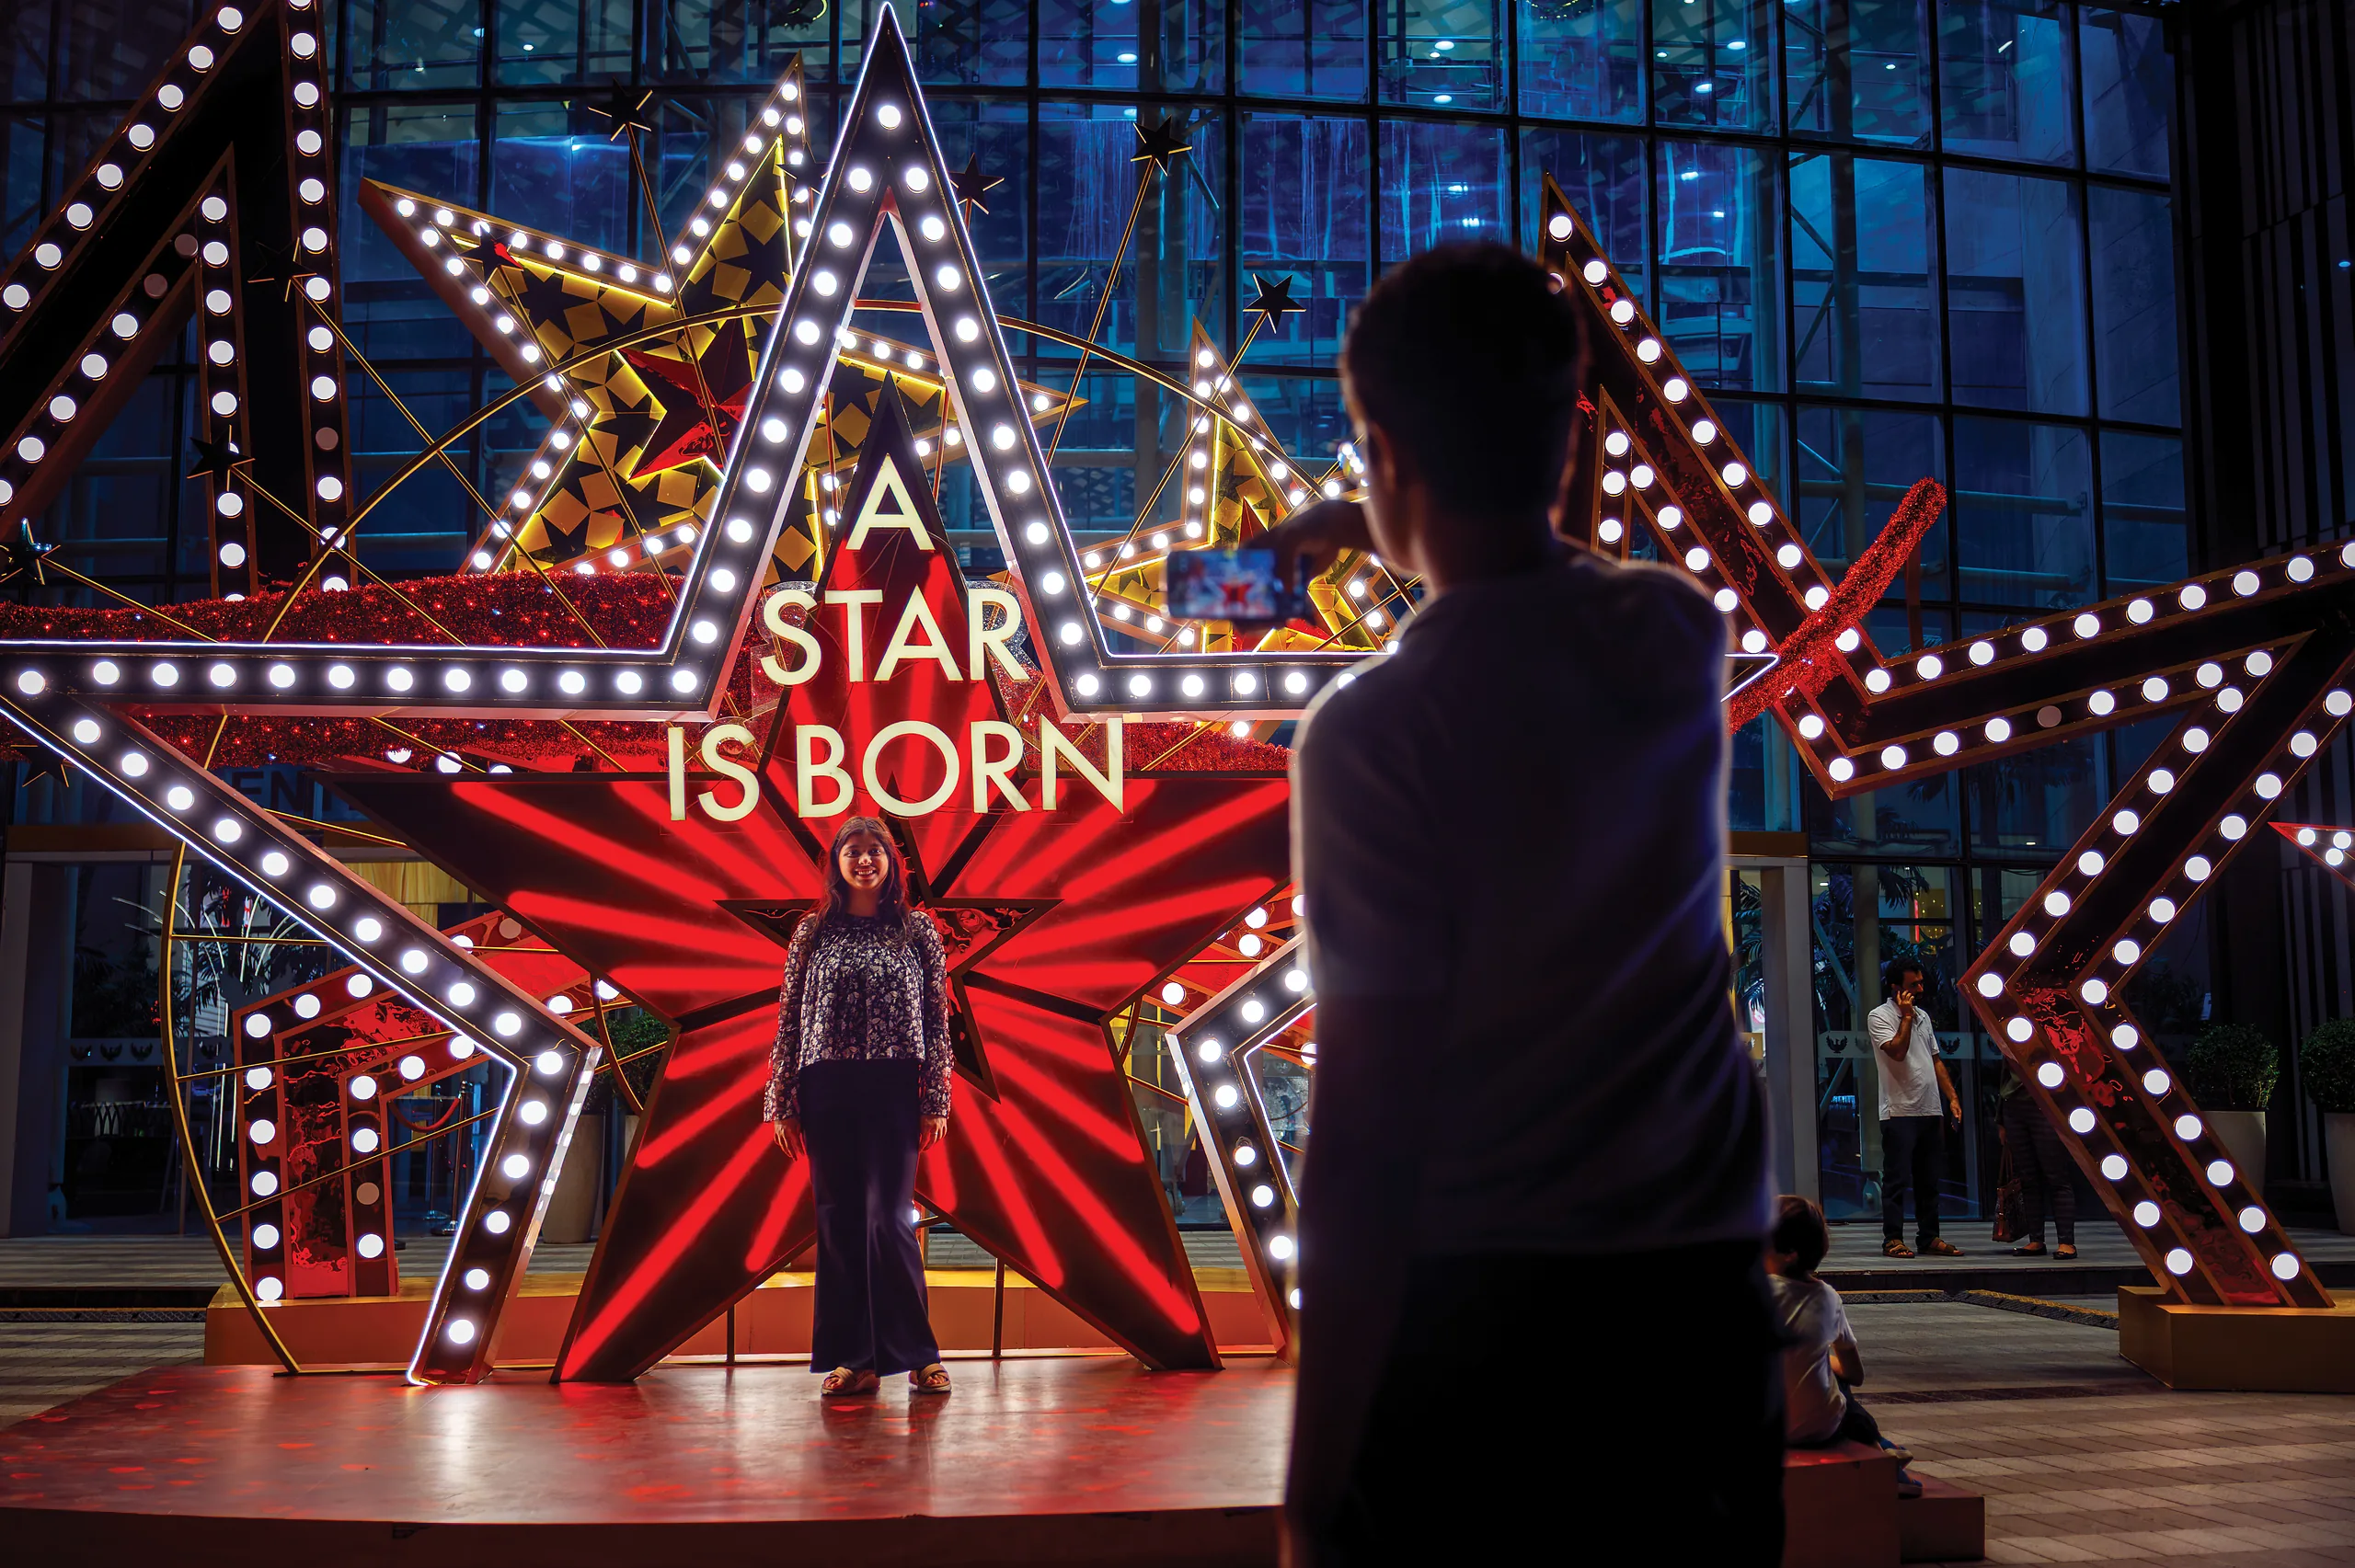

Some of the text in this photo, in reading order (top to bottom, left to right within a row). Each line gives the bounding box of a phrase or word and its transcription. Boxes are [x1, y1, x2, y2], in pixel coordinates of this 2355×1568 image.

[846, 453, 935, 551] A
[761, 584, 1030, 686] STAR
[667, 713, 1124, 823] IS BORN
